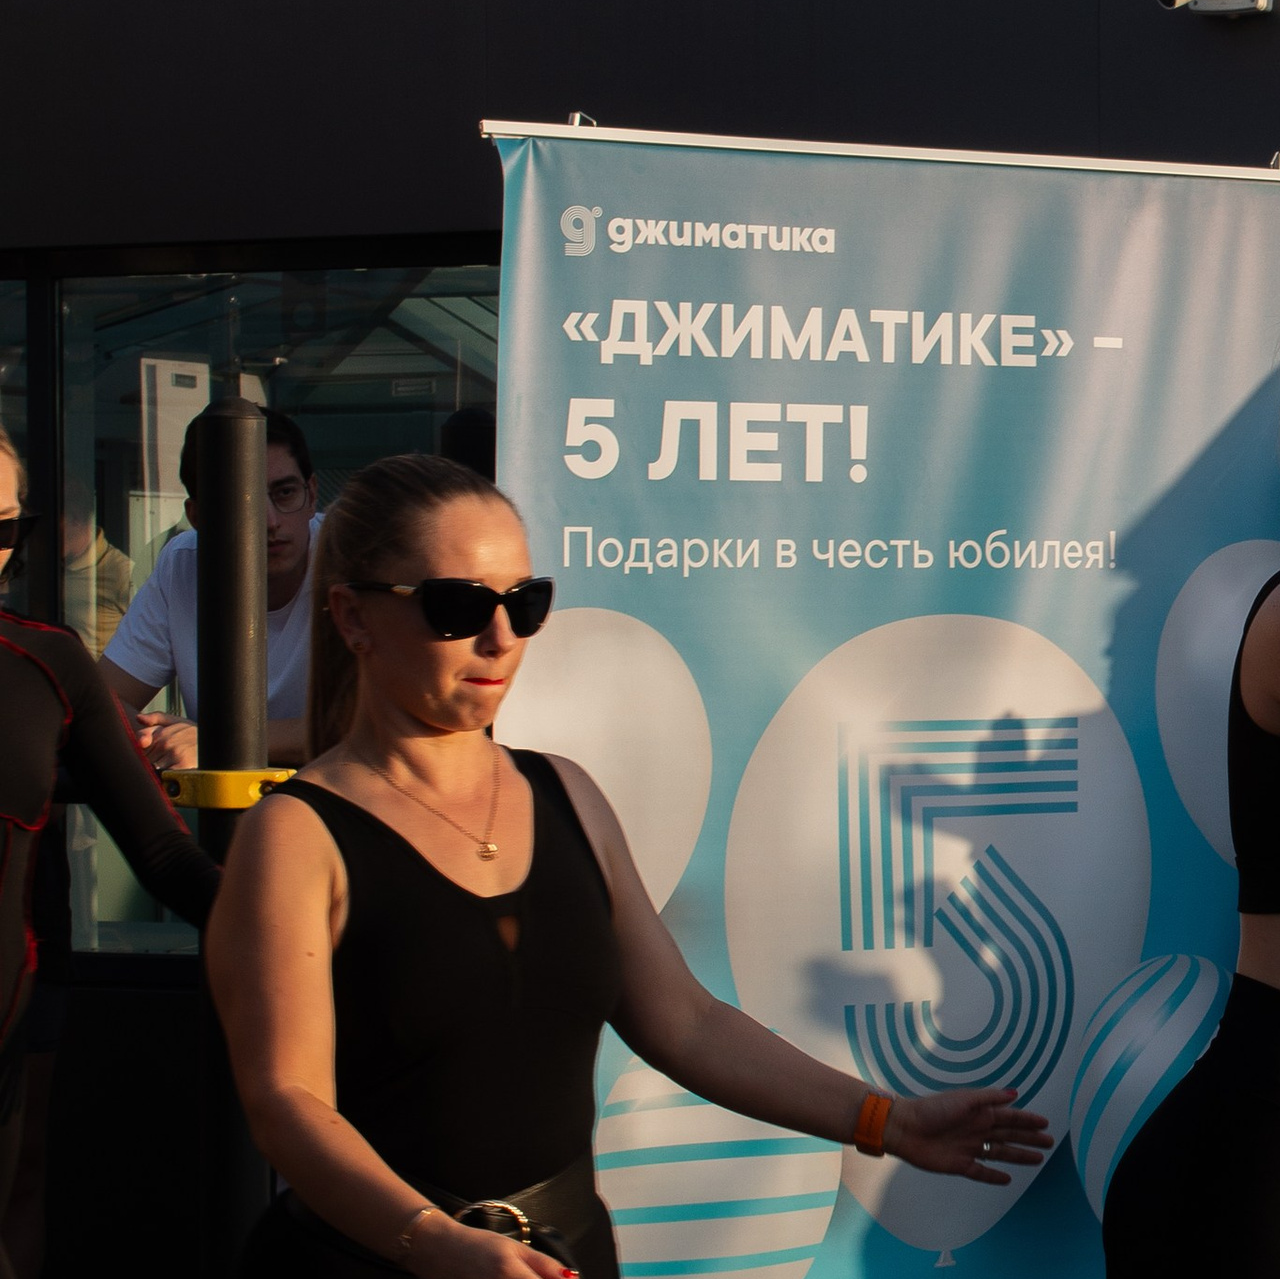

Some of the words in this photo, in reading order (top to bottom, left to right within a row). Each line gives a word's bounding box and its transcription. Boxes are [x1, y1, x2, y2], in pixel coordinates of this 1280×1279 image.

[561, 299, 1075, 367] «ДЖИМАТИКЕ»
[563, 398, 620, 480] 5
[648, 400, 869, 483] ЛЕТ!
[563, 526, 760, 578] Подарки
[776, 539, 798, 568] в
[811, 539, 934, 569] честь
[949, 529, 1117, 569] юбилея!
